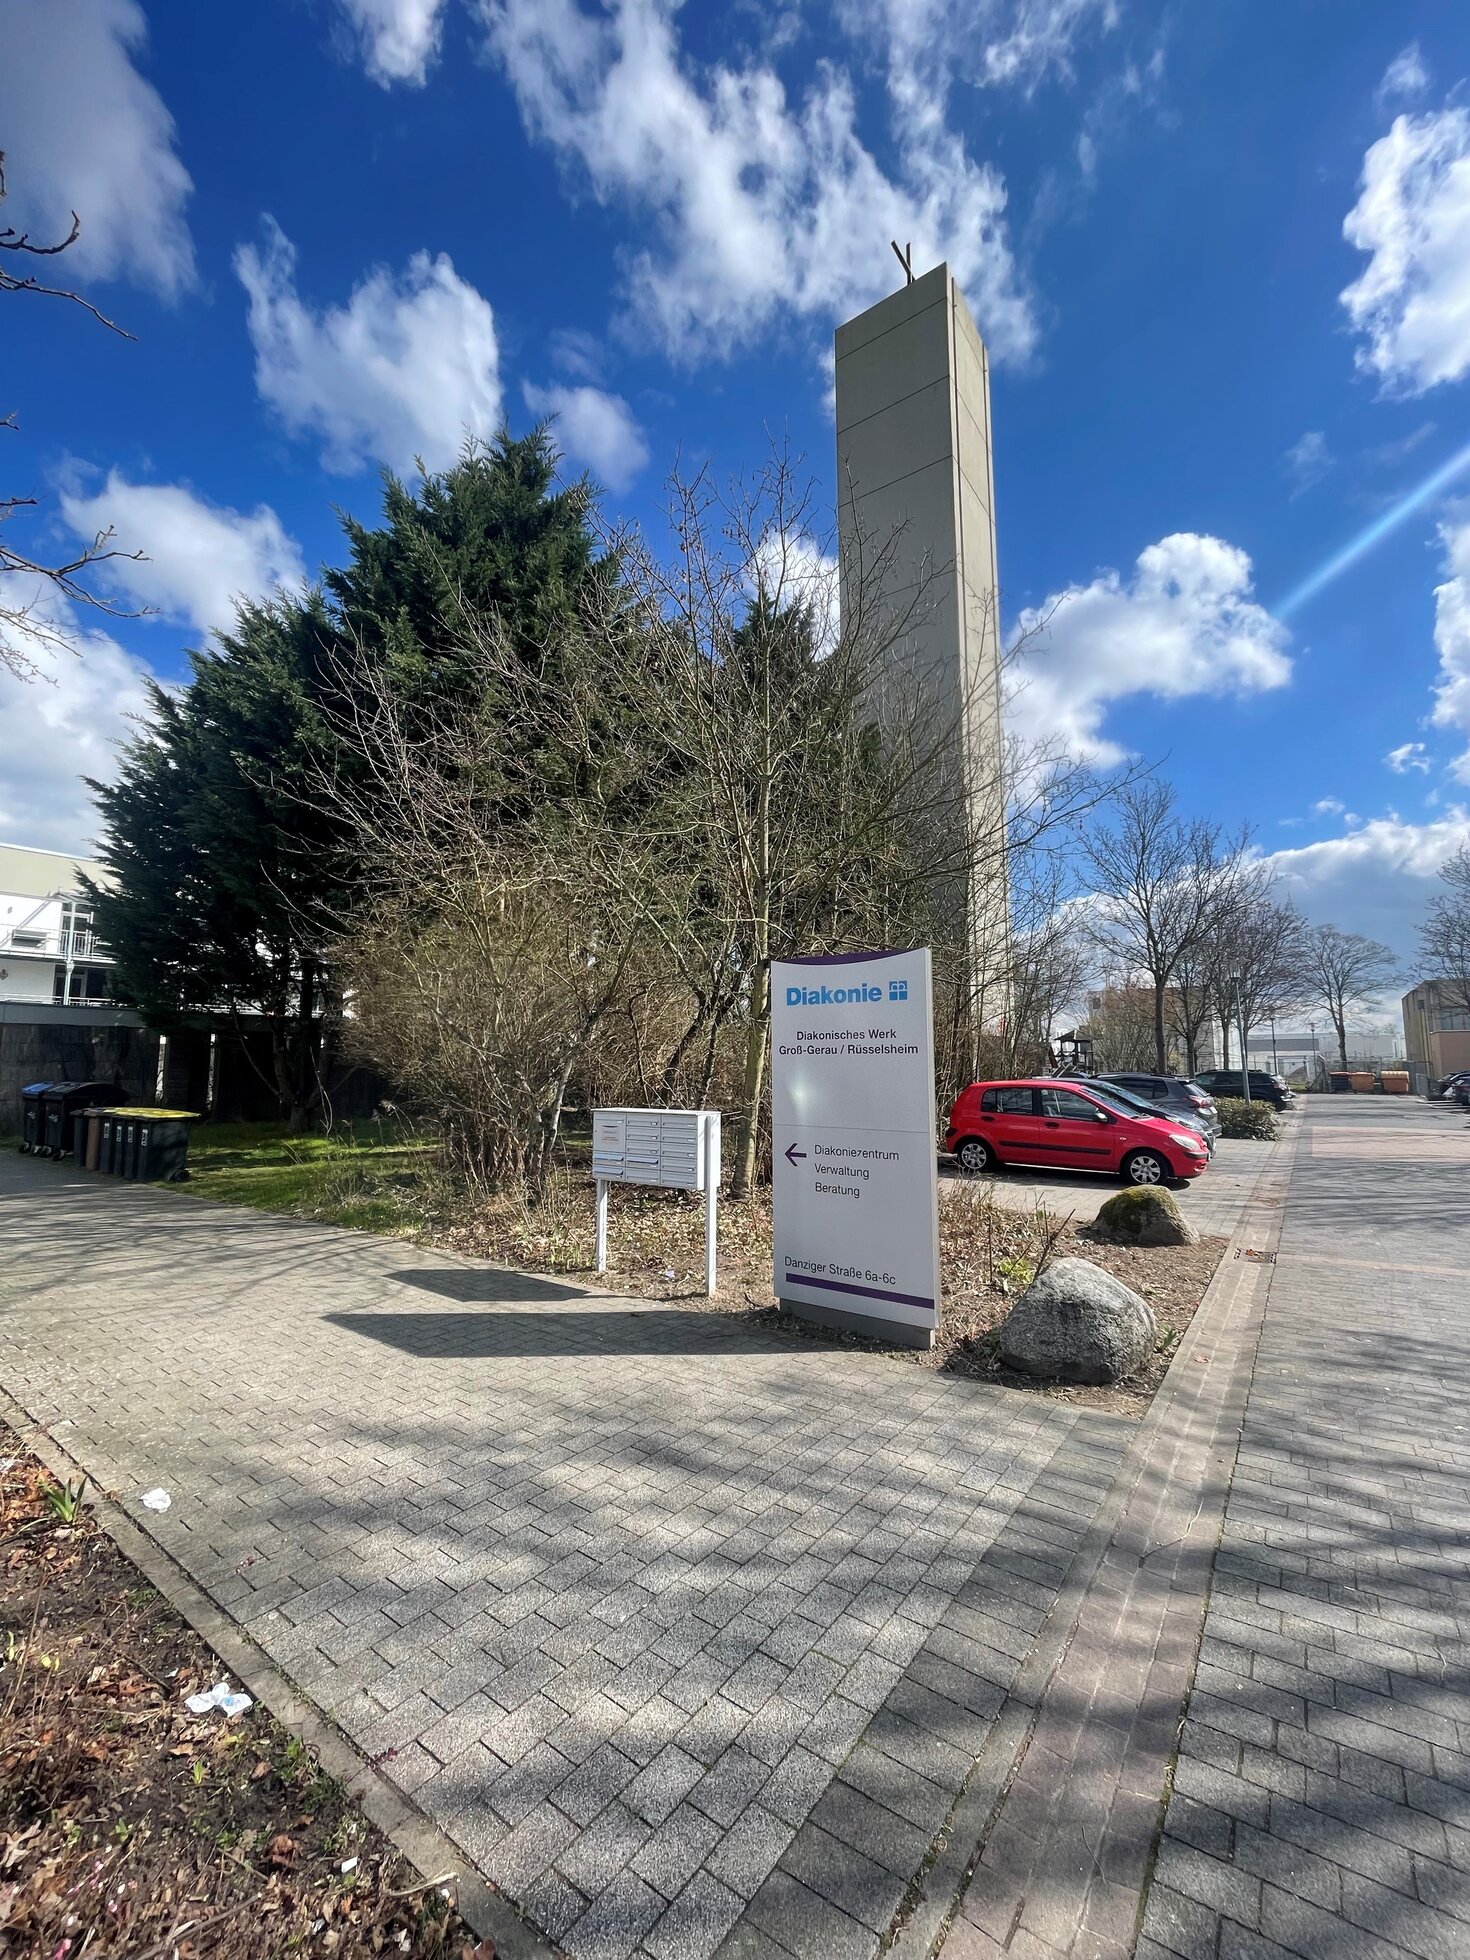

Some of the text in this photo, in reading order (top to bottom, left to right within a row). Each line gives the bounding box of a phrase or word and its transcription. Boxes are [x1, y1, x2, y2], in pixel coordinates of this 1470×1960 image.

[786, 983, 883, 1006] Diakonie
[796, 1028, 897, 1041] Diakonisches Werk
[779, 1044, 919, 1055] Groß-Gerau / Rüsselsheim
[814, 1144, 900, 1161] Diakoniezentrum
[814, 1163, 870, 1180] Verwaltung
[815, 1182, 860, 1199] Beratung
[784, 1256, 897, 1285] Danziger Straße 6a-6c
